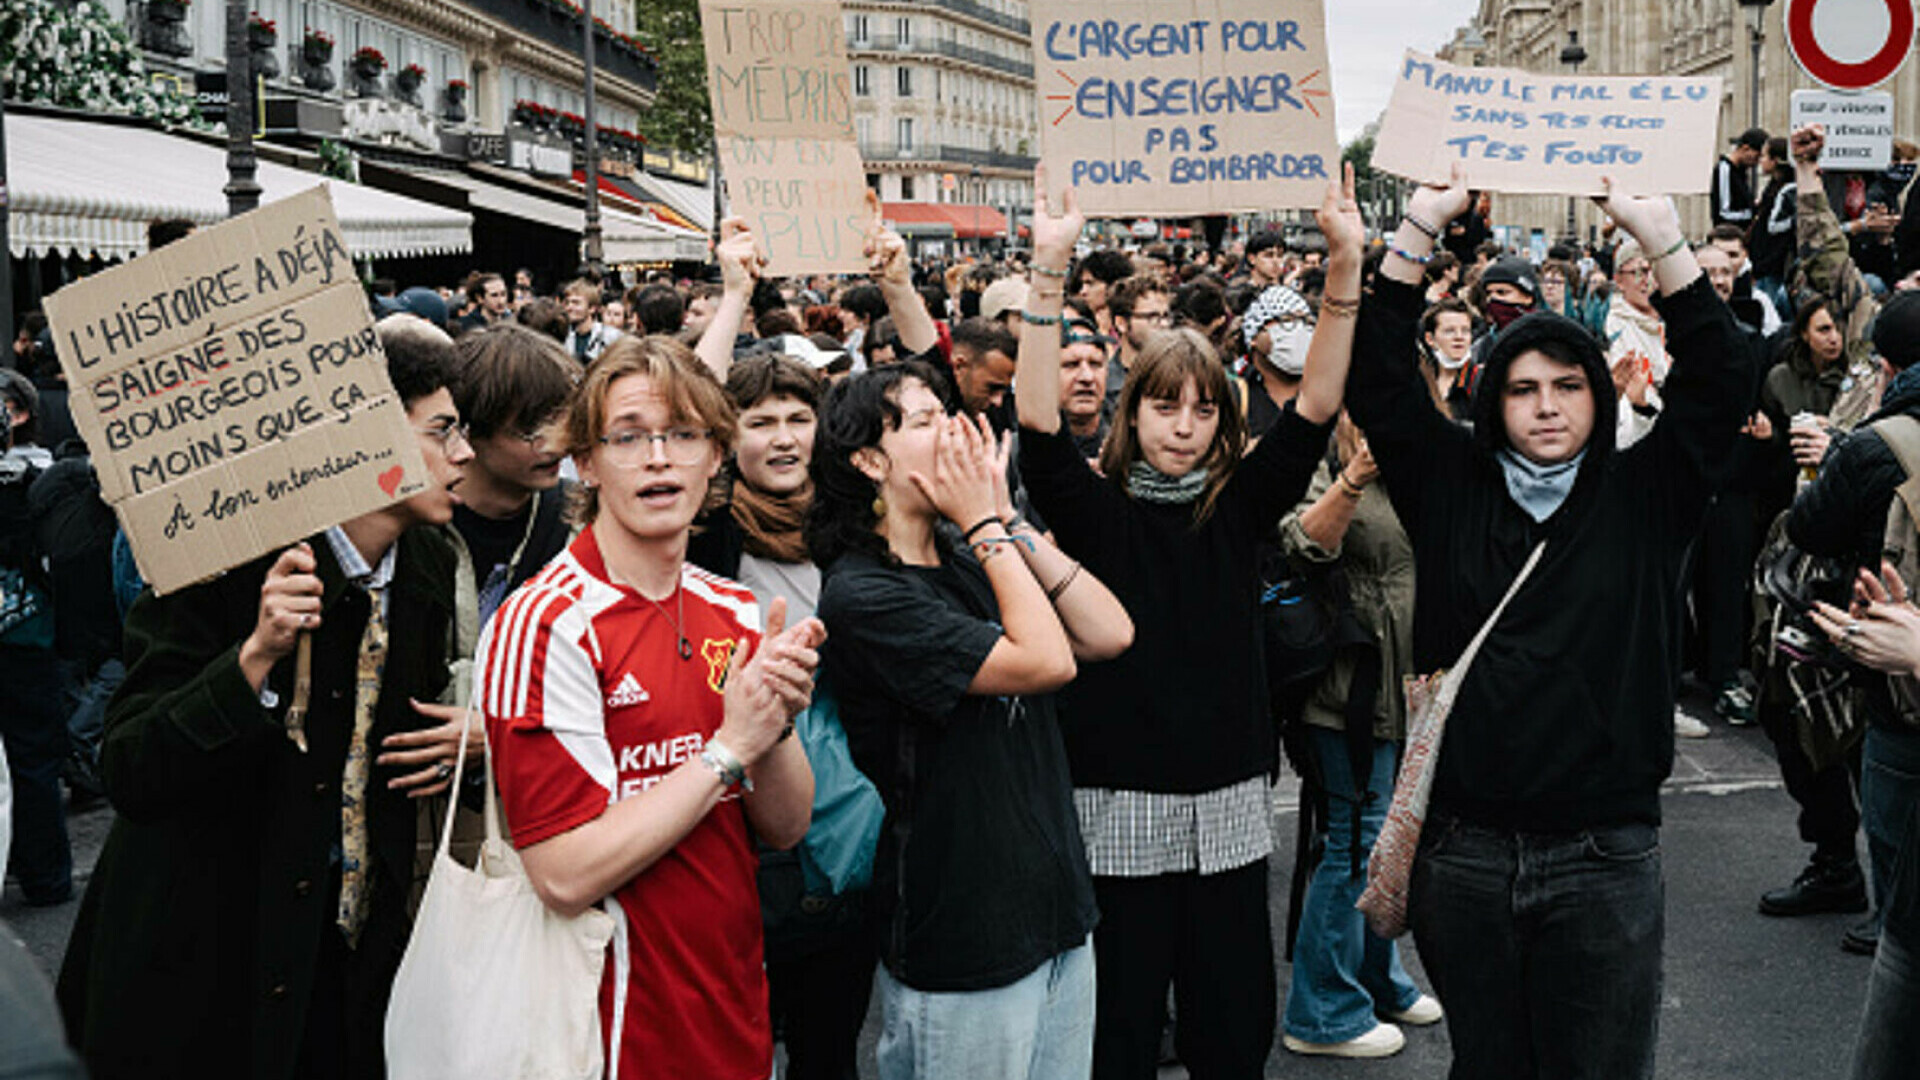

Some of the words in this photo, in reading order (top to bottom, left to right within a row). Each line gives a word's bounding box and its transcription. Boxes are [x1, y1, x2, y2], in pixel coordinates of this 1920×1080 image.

[714, 8, 804, 54] TROP
[815, 14, 843, 57] DE
[1045, 20, 1210, 61] L'ARGENT
[1221, 20, 1306, 51] POUR
[1076, 73, 1303, 119] ENSEIGNER
[1402, 58, 1494, 95] MANU
[1551, 83, 1613, 100] MAL
[1452, 105, 1529, 129] SANS
[1539, 112, 1590, 129] TES
[731, 134, 776, 165] ON
[1145, 124, 1218, 154] PAS
[1072, 159, 1151, 186] POUR
[1169, 153, 1328, 184] BOMBARDER
[743, 176, 807, 210] PEUT
[759, 212, 866, 262] PLUS
[255, 256, 280, 294] A
[236, 308, 306, 362] DES
[308, 327, 383, 374] POUR
[256, 396, 322, 442] QUE
[203, 490, 260, 520] bon
